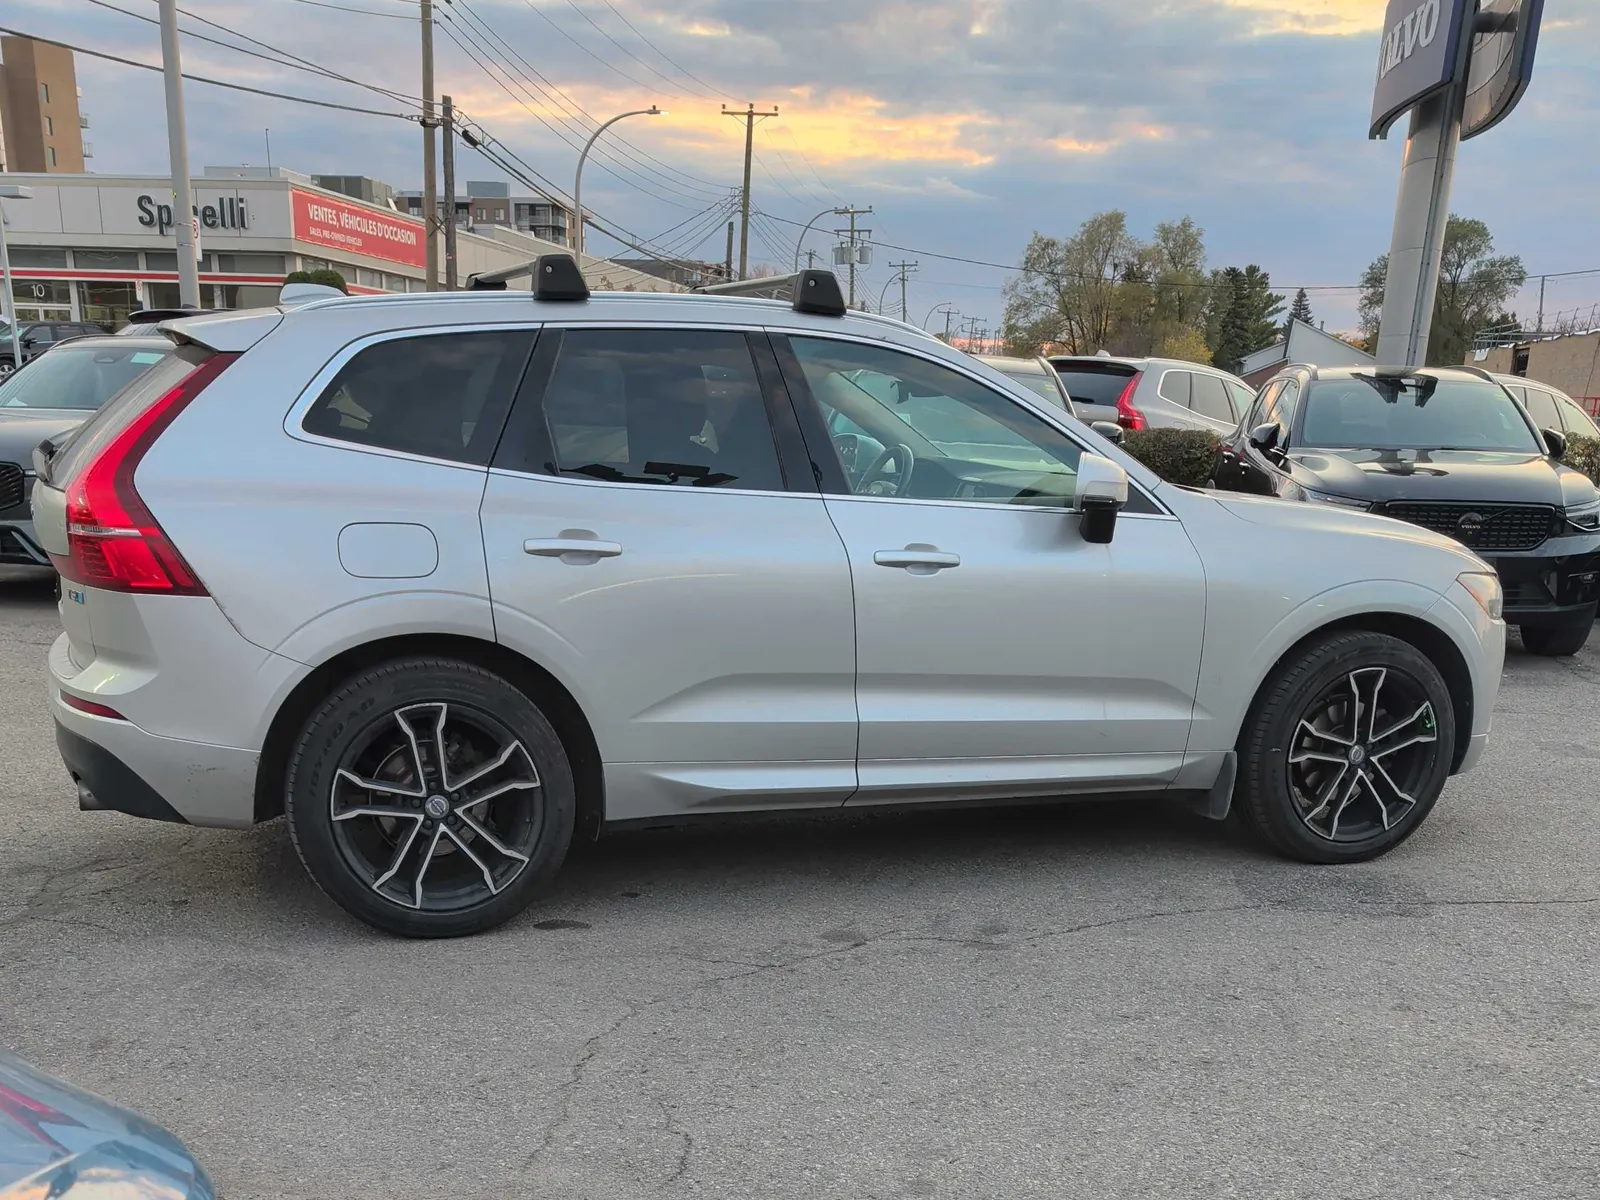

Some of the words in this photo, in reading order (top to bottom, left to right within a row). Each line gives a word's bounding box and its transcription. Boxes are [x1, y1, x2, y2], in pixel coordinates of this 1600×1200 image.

[1380, 0, 1440, 79] OLVO
[137, 195, 247, 236] Spelli
[308, 203, 340, 228] VENTES,
[340, 209, 377, 236] VÉHICULES
[378, 223, 416, 246] D'OCCASION
[31, 284, 45, 298] 10
